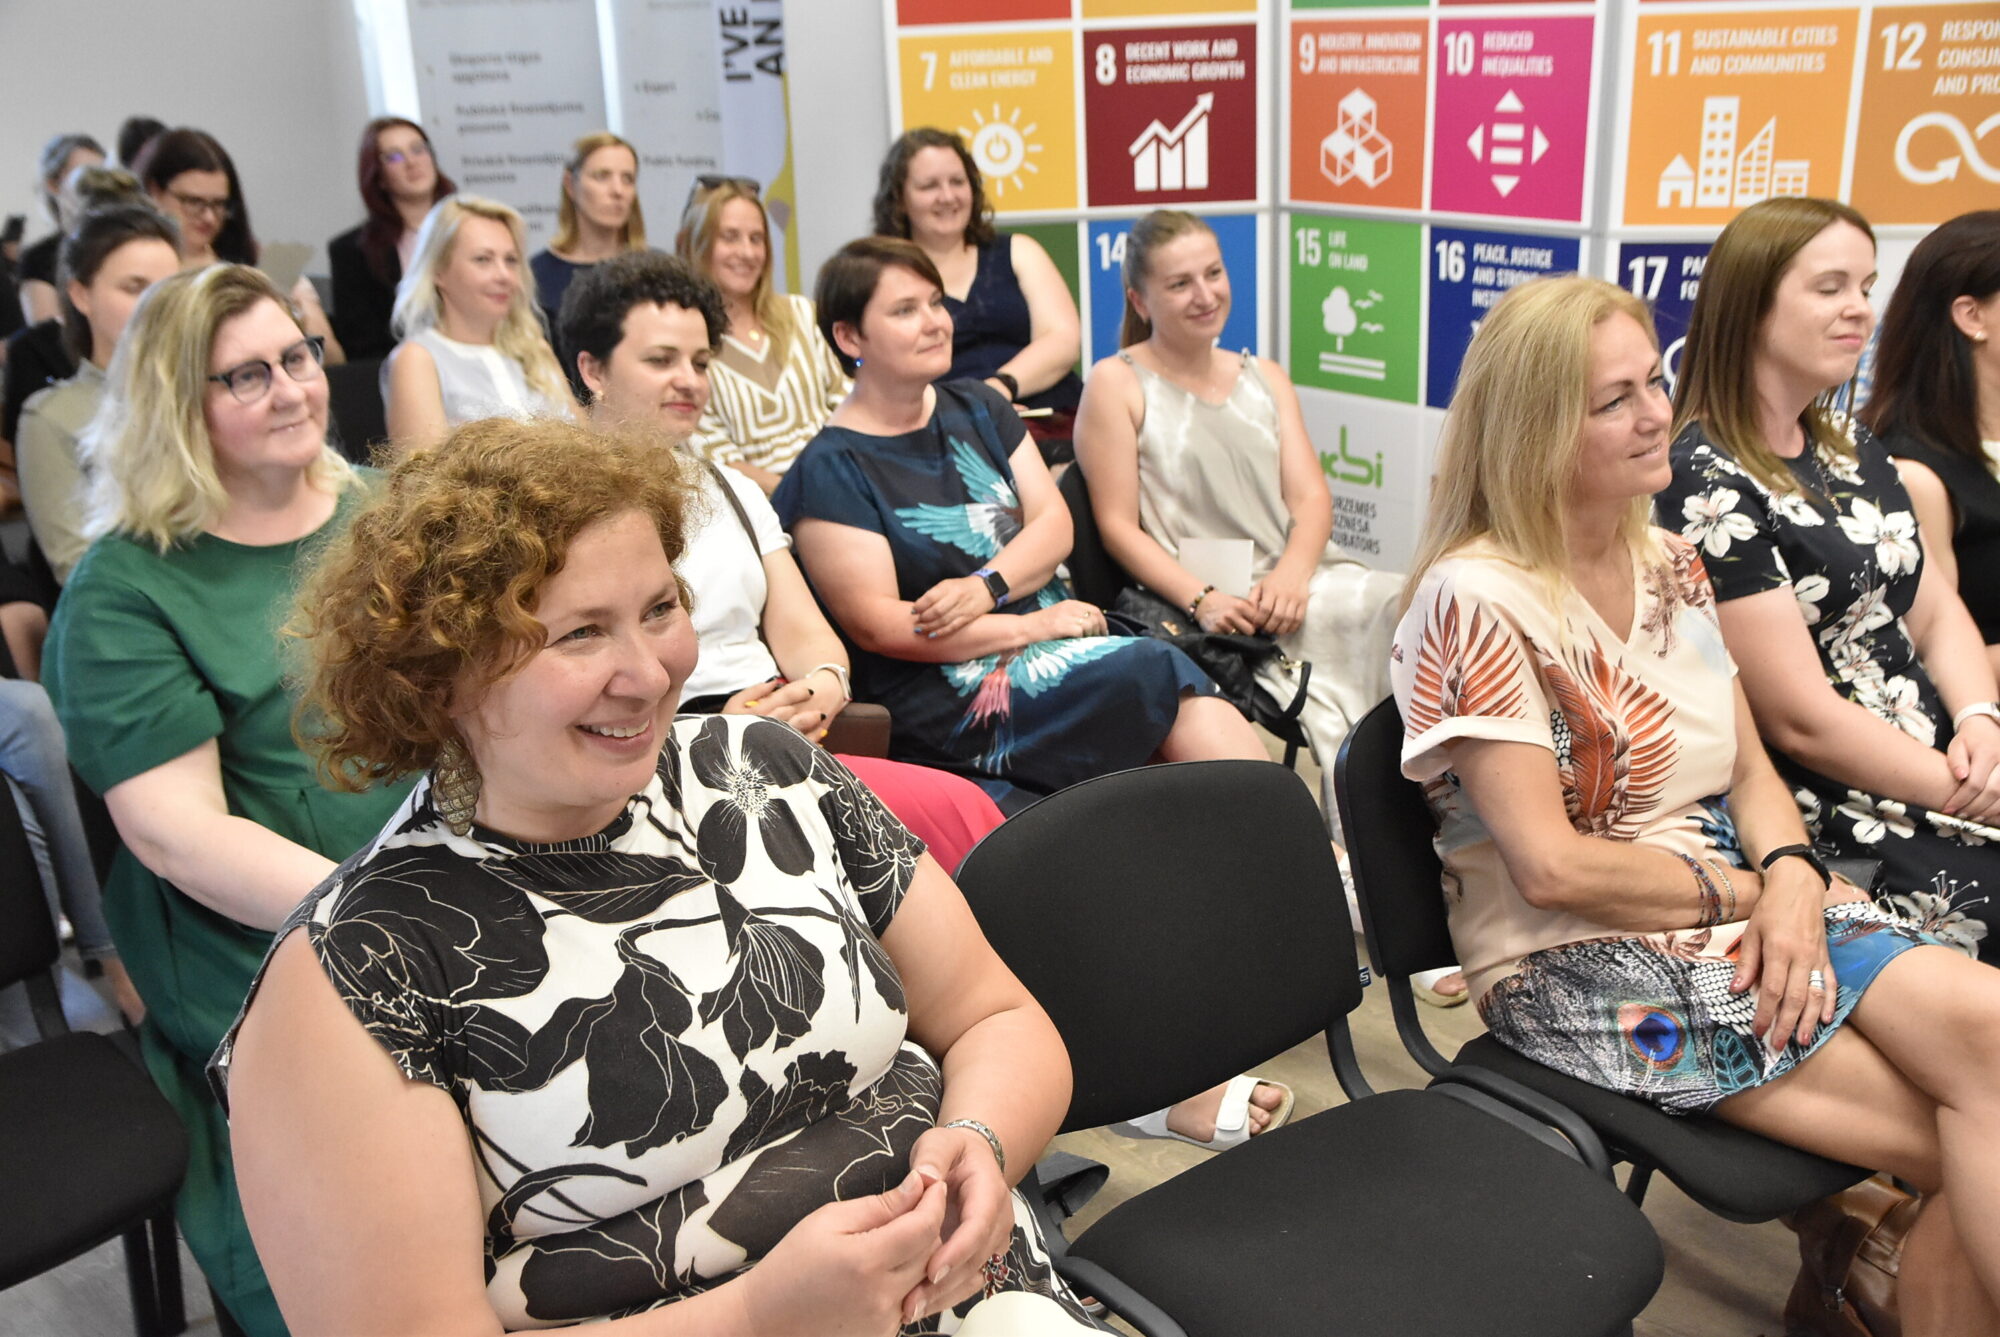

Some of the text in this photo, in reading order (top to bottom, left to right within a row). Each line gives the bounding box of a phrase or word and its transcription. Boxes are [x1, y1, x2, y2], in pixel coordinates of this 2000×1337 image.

[719, 8, 752, 82] I'VE
[752, 19, 784, 77] AN
[1365, 31, 1422, 50] INNOVATION
[1482, 30, 1534, 53] REDUCED
[1692, 25, 1839, 49] SUSTAINABLE CITIES
[1880, 22, 1927, 70] 12
[950, 46, 1053, 67] AFFORDABLE AND
[1125, 38, 1238, 63] DECENT WORK AND
[1298, 33, 1316, 75] 9
[1443, 31, 1475, 76] 10
[1647, 30, 1682, 77] 11
[919, 52, 938, 91] 7
[1095, 43, 1117, 86] 8
[1126, 60, 1246, 85] ECONOMIC GROWTH
[1318, 55, 1421, 75] AND INFRASTRUCTURE
[1481, 55, 1554, 78] INEQUALITIES
[1690, 53, 1826, 76] AND COMMUNITIES
[950, 69, 1037, 90] CLEAN ENERGY
[1932, 74, 1969, 96] AND
[1095, 232, 1127, 270] 14
[1295, 227, 1322, 267] 15
[1328, 230, 1347, 249] LIFE
[1328, 251, 1368, 272] ON LAND
[1435, 239, 1465, 282] 16
[1473, 243, 1553, 269] PEACE, JUSTICE
[1472, 266, 1496, 286] AND
[1628, 255, 1668, 301] 17
[1680, 280, 1700, 301] FO
